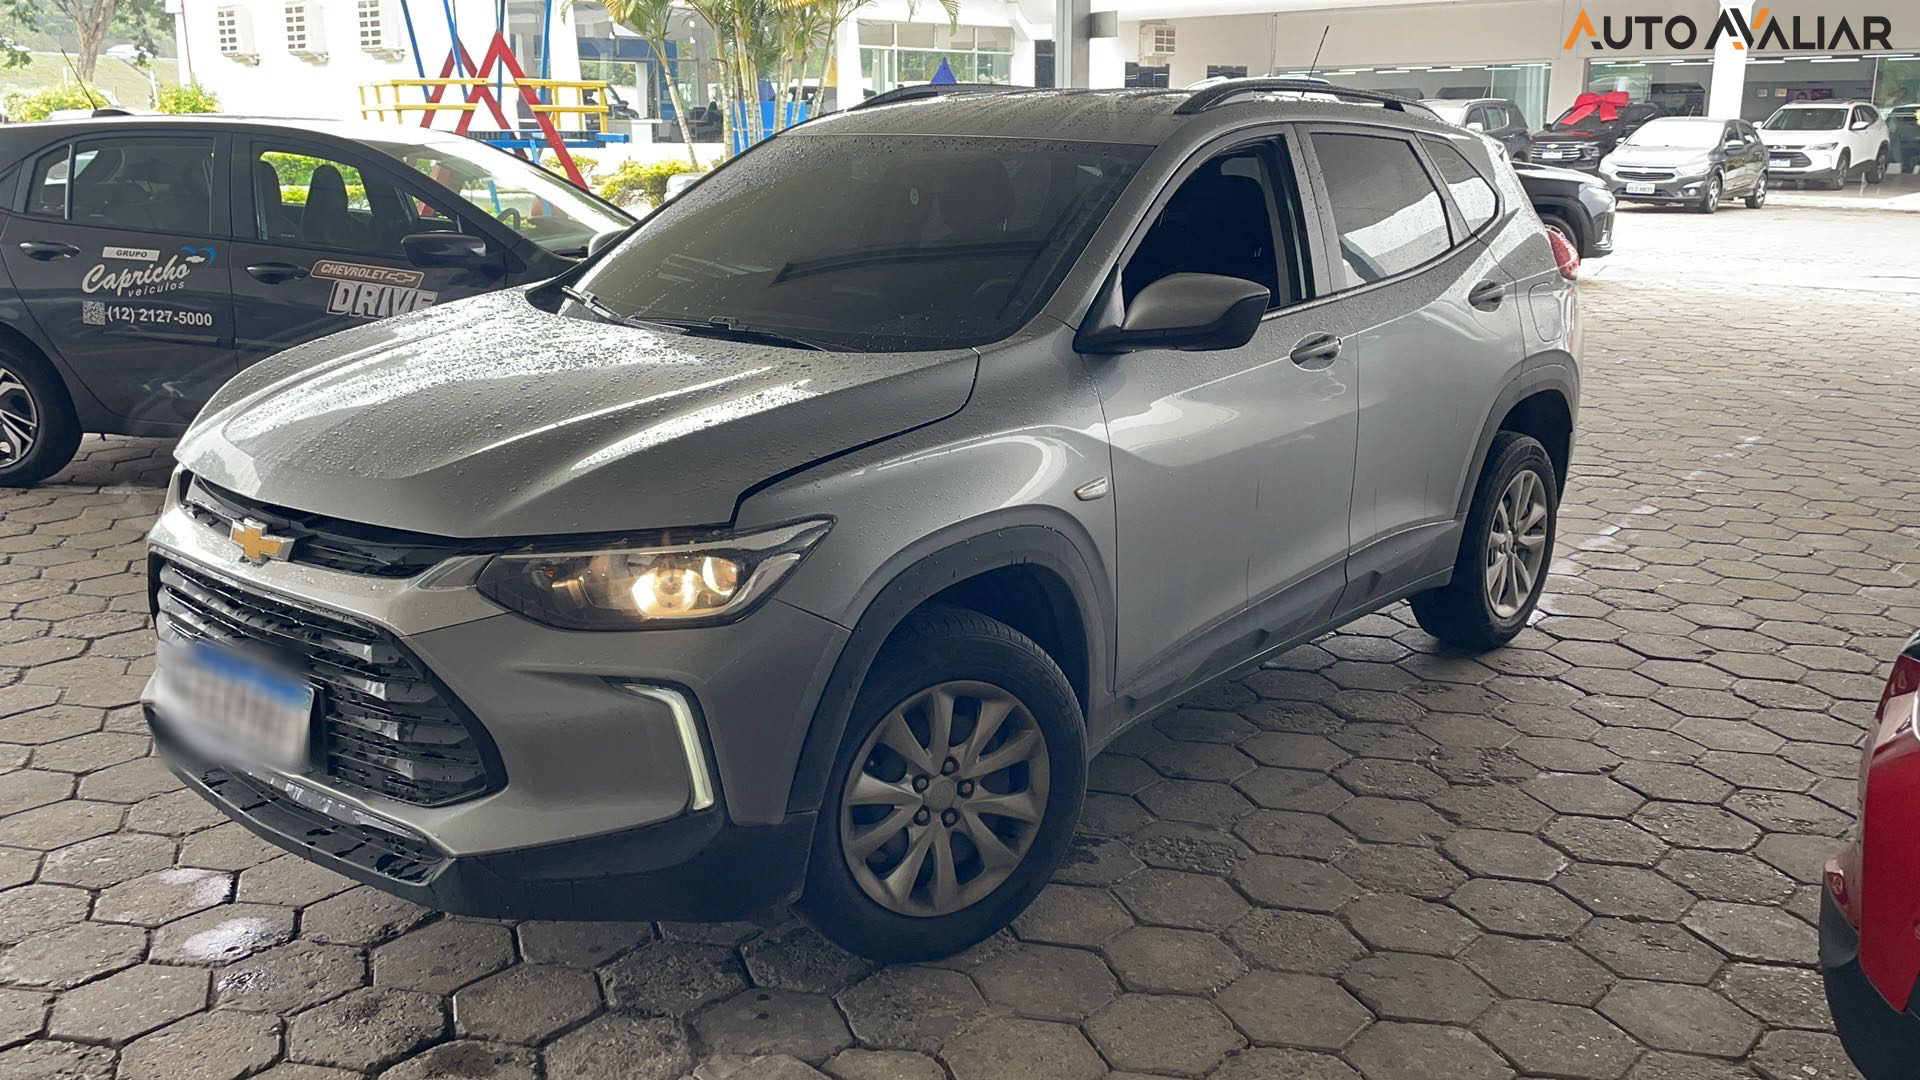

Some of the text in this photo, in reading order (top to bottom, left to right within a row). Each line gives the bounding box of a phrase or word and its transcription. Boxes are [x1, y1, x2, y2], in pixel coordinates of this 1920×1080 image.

[115, 249, 148, 258] GRUPO
[81, 254, 191, 296] Capricho
[320, 263, 388, 280] CHEVROLET
[107, 306, 213, 326] (12) 2127-5000
